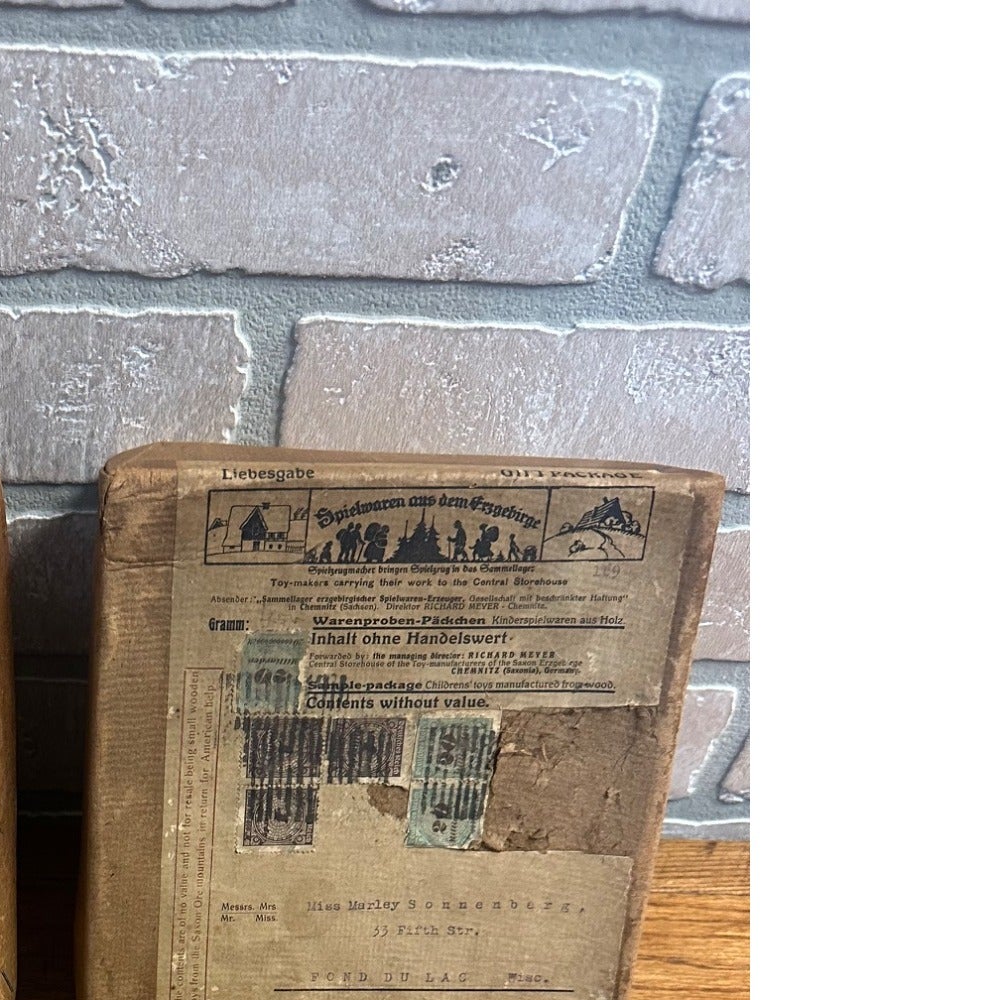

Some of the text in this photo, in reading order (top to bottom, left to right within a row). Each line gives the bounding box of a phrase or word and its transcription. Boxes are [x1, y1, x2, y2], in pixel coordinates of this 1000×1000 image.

[222, 468, 315, 482] Liebesgabe
[314, 493, 541, 530] Spielwaren aus dem Erzgebirge
[270, 577, 568, 590] Toy-makers carrying their work to the Central Storehouse
[208, 617, 250, 631] Gramm:
[313, 616, 486, 627] Warenproben-Päckchen
[492, 616, 577, 627] Kinderspielwaren
[579, 616, 597, 625] aus
[310, 632, 357, 646] Inhalt
[362, 632, 401, 645] ohne
[189, 671, 198, 714] wooden
[306, 680, 422, 692] Sample-package
[473, 680, 494, 691] toys
[495, 679, 561, 689] manufactured
[305, 695, 490, 710] Contents without value.
[187, 718, 196, 745] small
[200, 712, 212, 762] American
[185, 749, 196, 777] being
[199, 769, 209, 783] for
[184, 780, 193, 809] resale
[199, 789, 208, 818] return
[182, 813, 191, 828] for
[181, 832, 190, 848] not
[180, 852, 189, 869] and
[195, 837, 206, 888] mountains
[179, 873, 188, 898] value
[194, 891, 202, 908] Ore
[307, 900, 341, 912] Miss
[348, 899, 400, 912] Marley
[179, 902, 187, 914] no
[192, 911, 201, 942] Saxon
[397, 924, 440, 936] Fifth
[447, 924, 480, 936] Str.
[178, 930, 186, 944] are
[190, 963, 199, 985] from
[384, 972, 410, 983] DU
[508, 972, 550, 983] Wisc.
